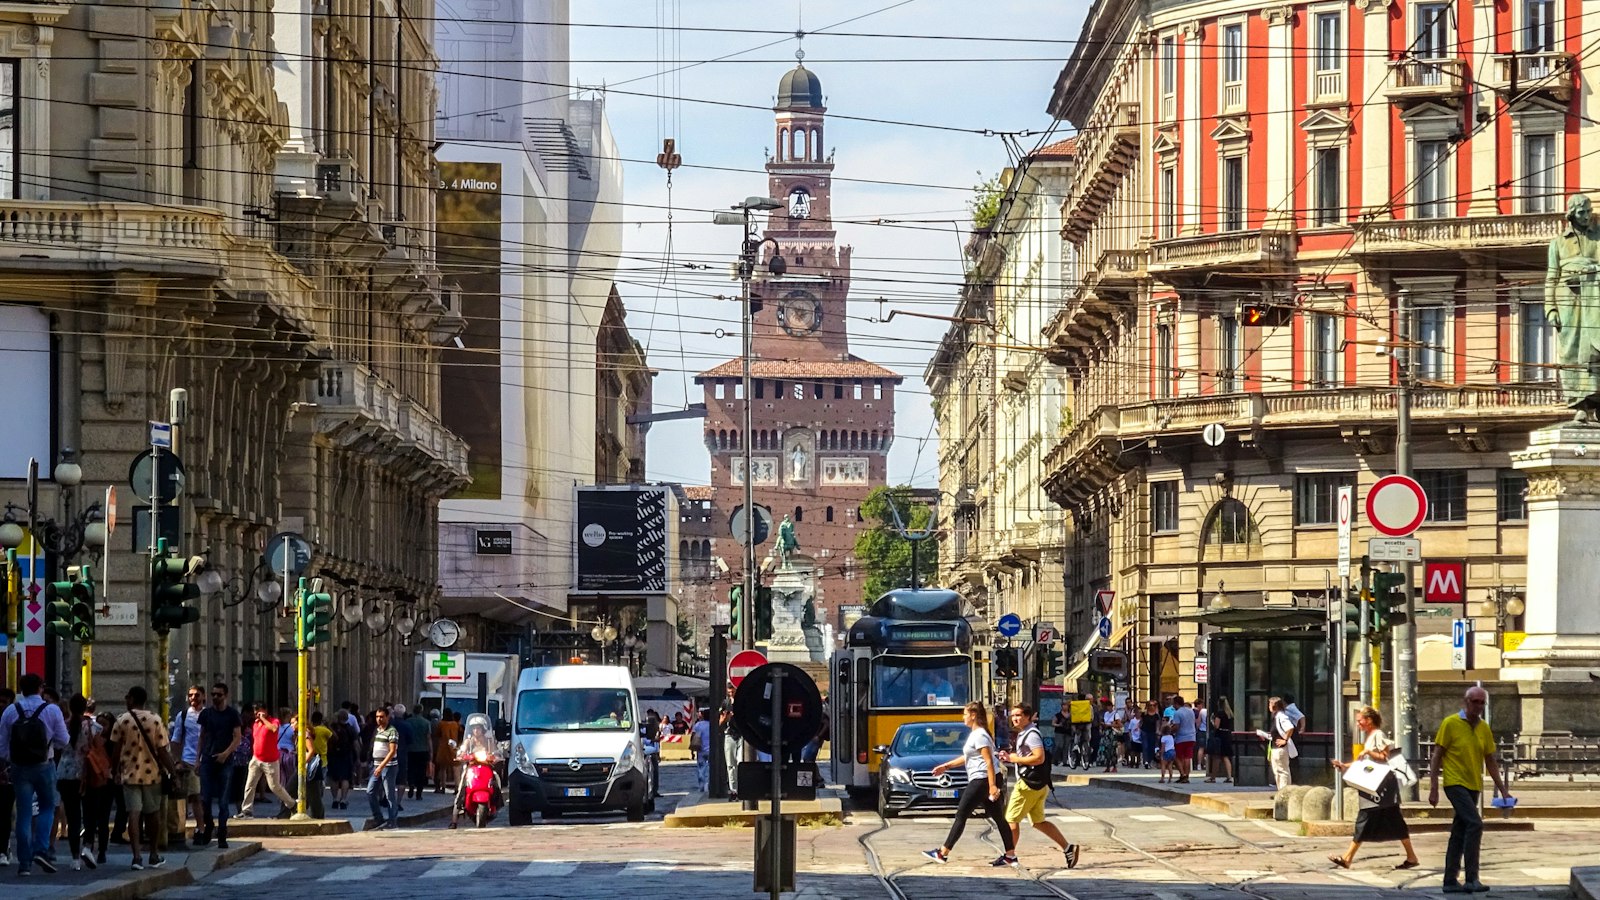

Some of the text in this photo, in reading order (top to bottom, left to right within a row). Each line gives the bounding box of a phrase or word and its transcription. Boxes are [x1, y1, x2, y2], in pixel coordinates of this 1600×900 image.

[451, 180, 458, 189] 4
[461, 179, 497, 190] Milano
[1428, 570, 1460, 594] M
